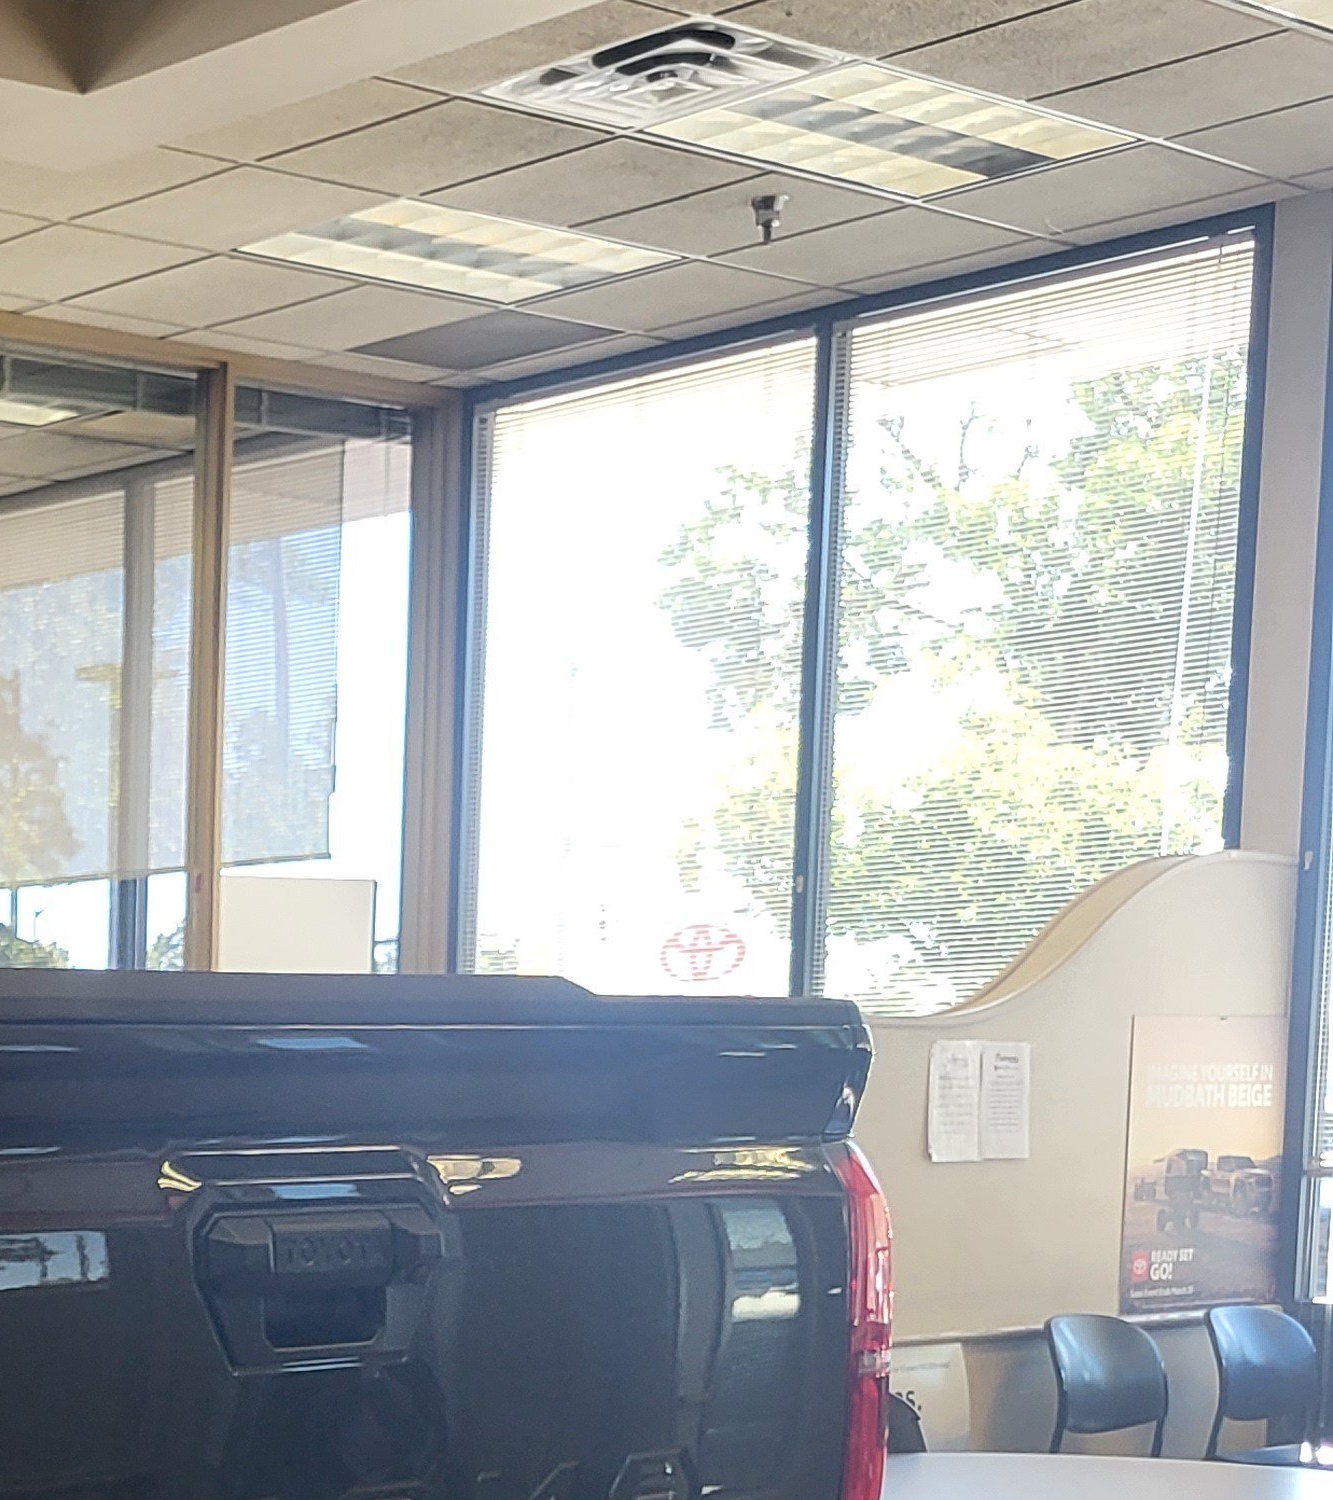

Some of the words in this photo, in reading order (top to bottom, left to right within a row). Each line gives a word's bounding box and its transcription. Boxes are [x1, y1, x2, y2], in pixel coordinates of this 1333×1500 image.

[1200, 1064, 1259, 1081] YOURSELF
[1261, 1064, 1273, 1081] IN
[1146, 1083, 1226, 1107] MUDBATH
[1229, 1083, 1273, 1107] BEIGE
[1151, 1250, 1178, 1262] READY
[1179, 1248, 1194, 1261] SET
[1150, 1263, 1173, 1281] GO!
